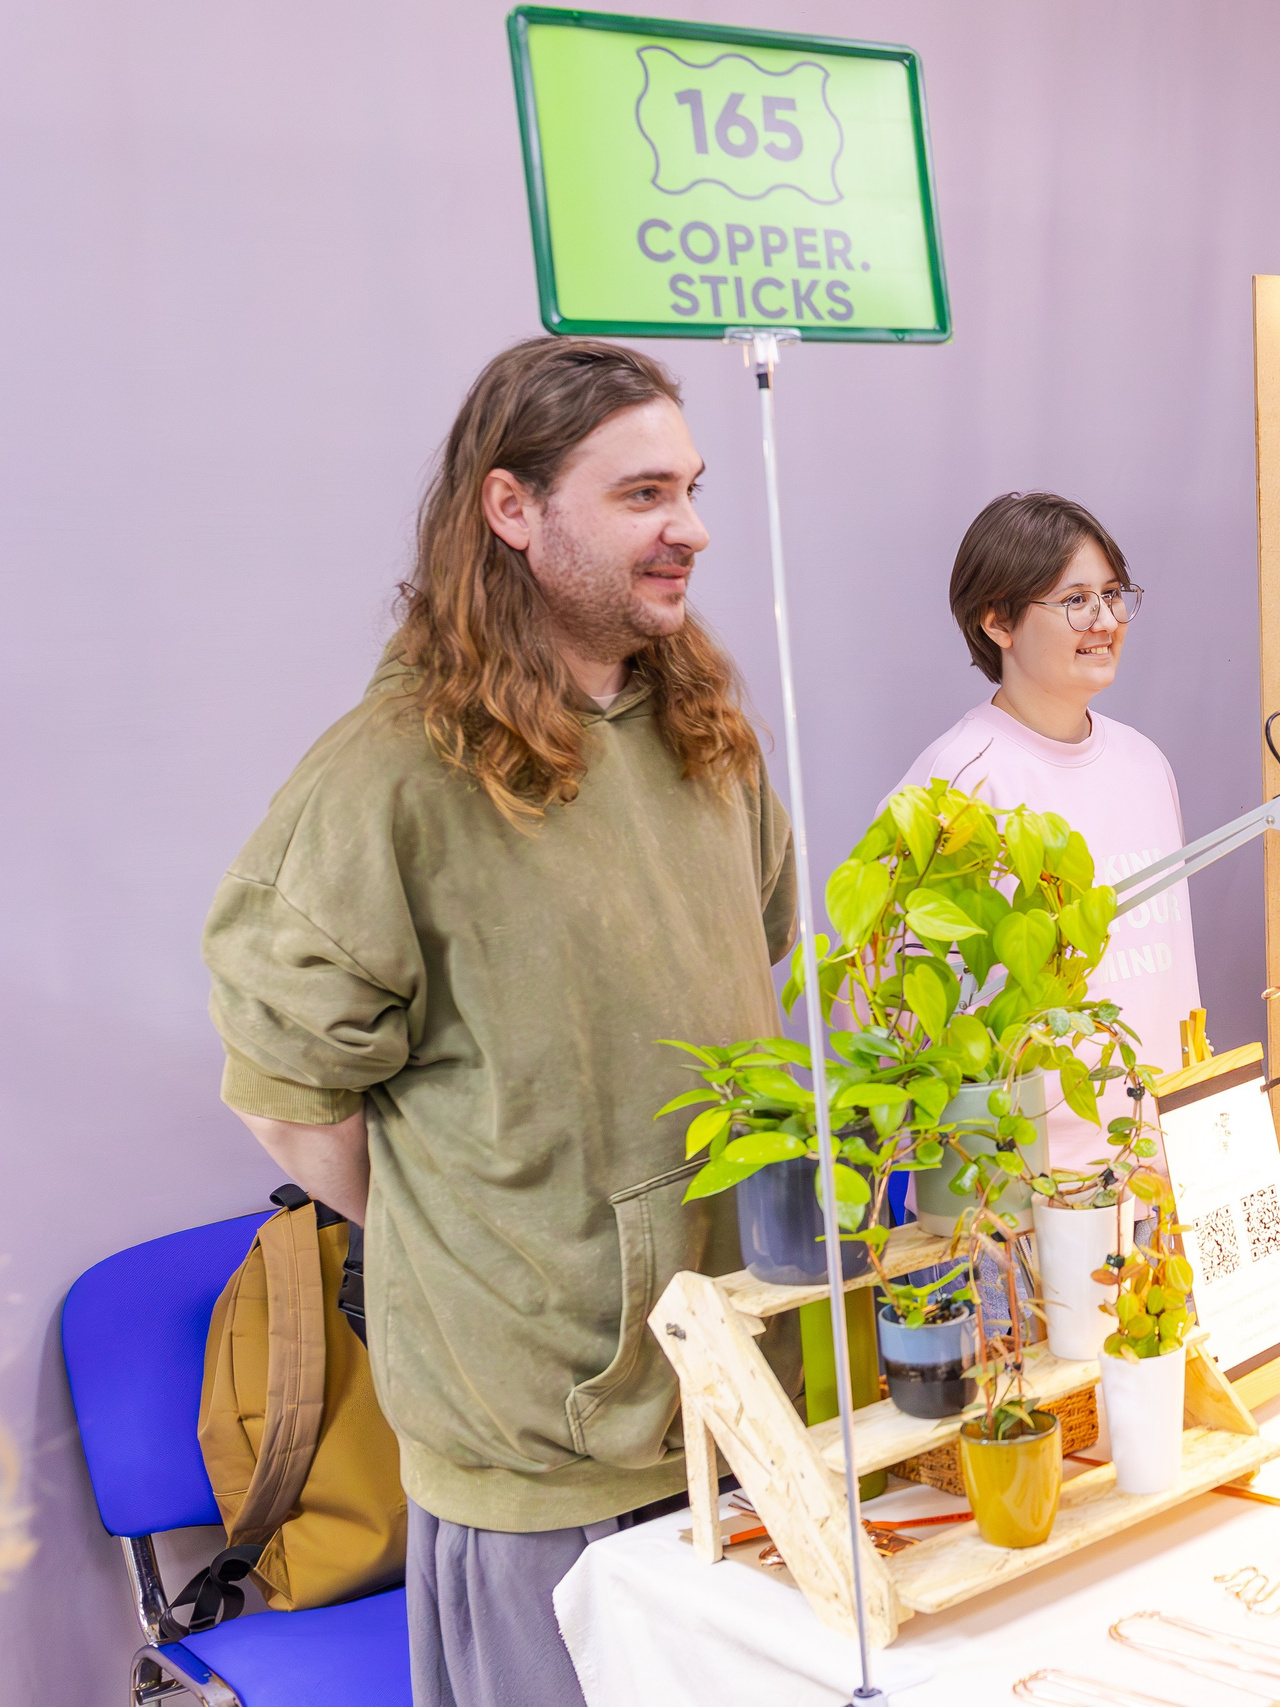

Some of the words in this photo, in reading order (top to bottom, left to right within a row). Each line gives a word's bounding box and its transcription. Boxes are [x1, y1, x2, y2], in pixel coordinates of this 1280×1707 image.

[674, 89, 804, 162] 165
[637, 218, 872, 273] COPPER.
[668, 273, 855, 322] STICKS
